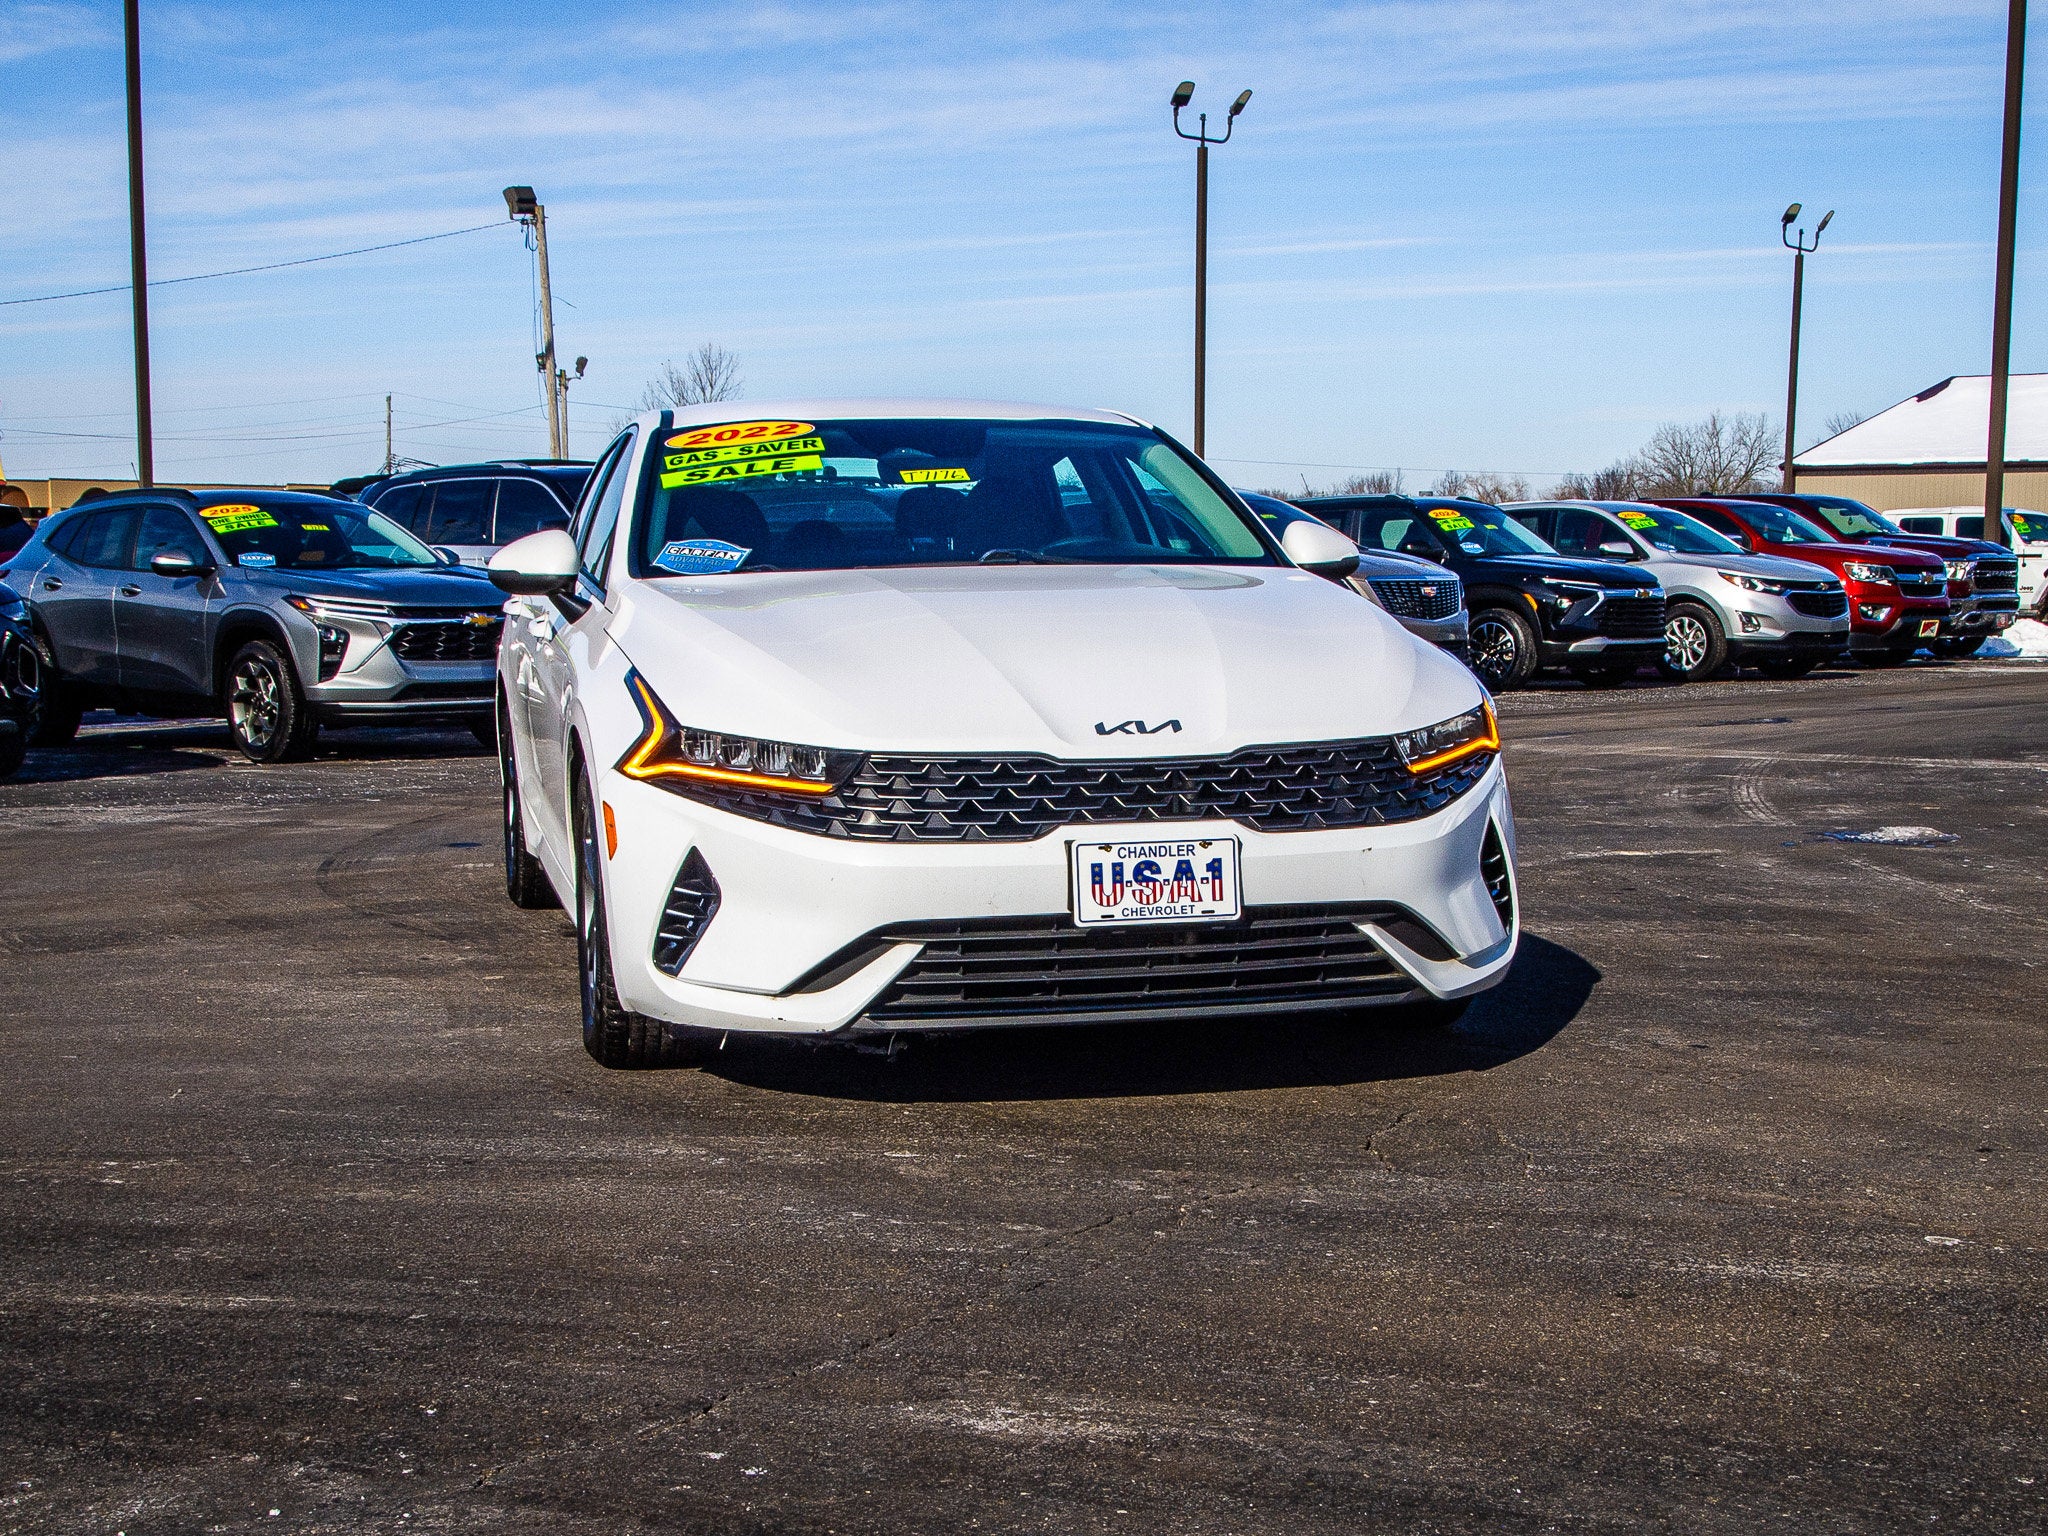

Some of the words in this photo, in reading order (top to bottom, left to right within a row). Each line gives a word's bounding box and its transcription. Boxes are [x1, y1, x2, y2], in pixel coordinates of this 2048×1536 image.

[683, 422, 800, 446] 2022
[669, 450, 719, 467] GAS
[738, 439, 819, 456] SAVER
[683, 459, 796, 482] SALE
[208, 506, 252, 516] 2025
[211, 518, 231, 526] ONE
[234, 513, 269, 521] OWNER
[226, 521, 266, 530] SALE
[667, 546, 740, 560] CARFAX
[1094, 719, 1183, 736] KIA
[1117, 844, 1196, 859] CHANDLER
[1121, 904, 1196, 917] CHEVROLET
